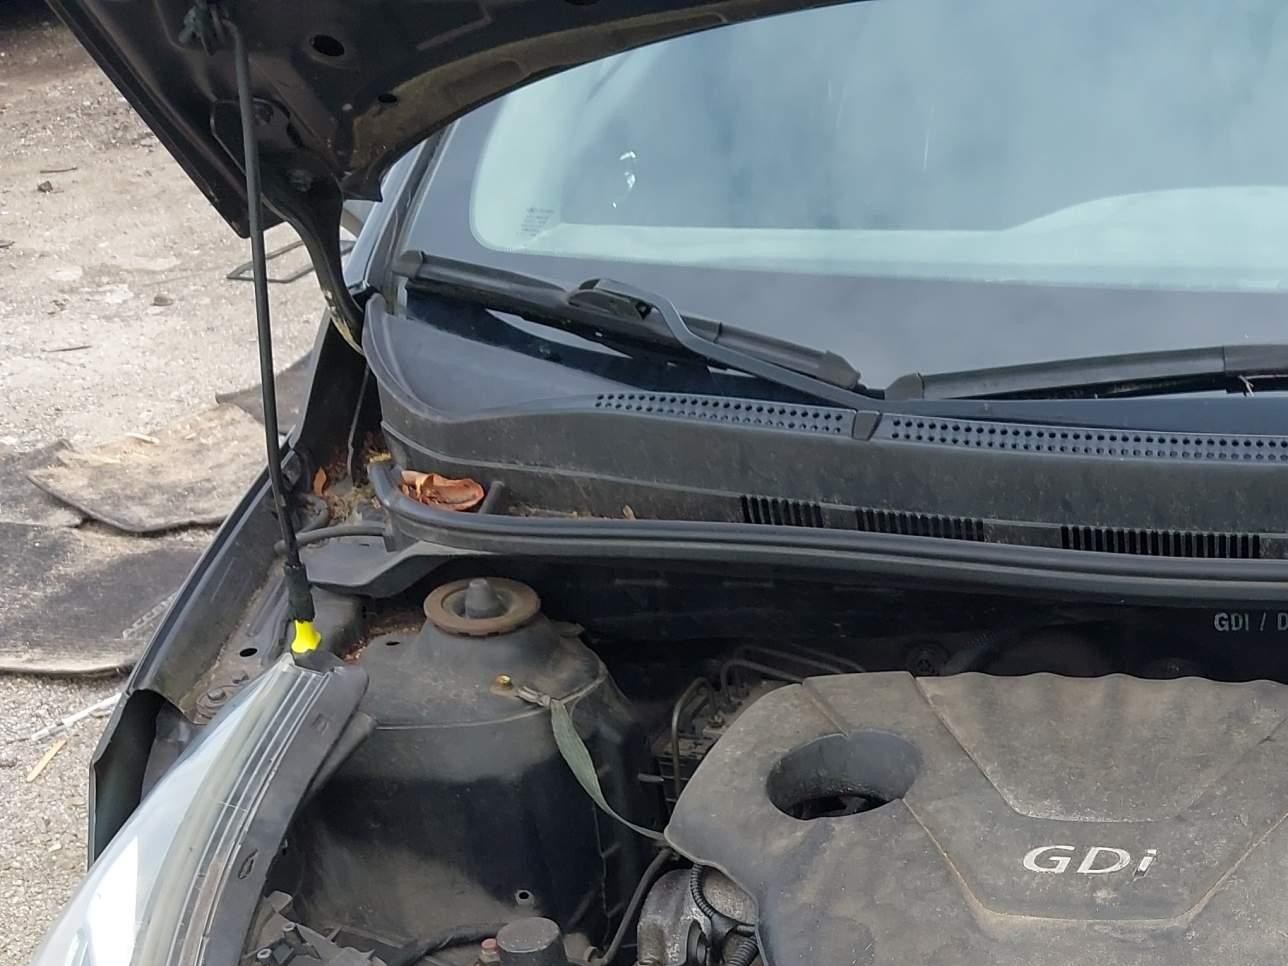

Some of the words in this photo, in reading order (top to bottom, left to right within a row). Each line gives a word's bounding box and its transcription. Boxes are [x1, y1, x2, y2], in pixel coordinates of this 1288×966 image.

[1214, 612, 1249, 631] GDI
[1259, 612, 1267, 631] /
[1022, 845, 1157, 878] GDi
